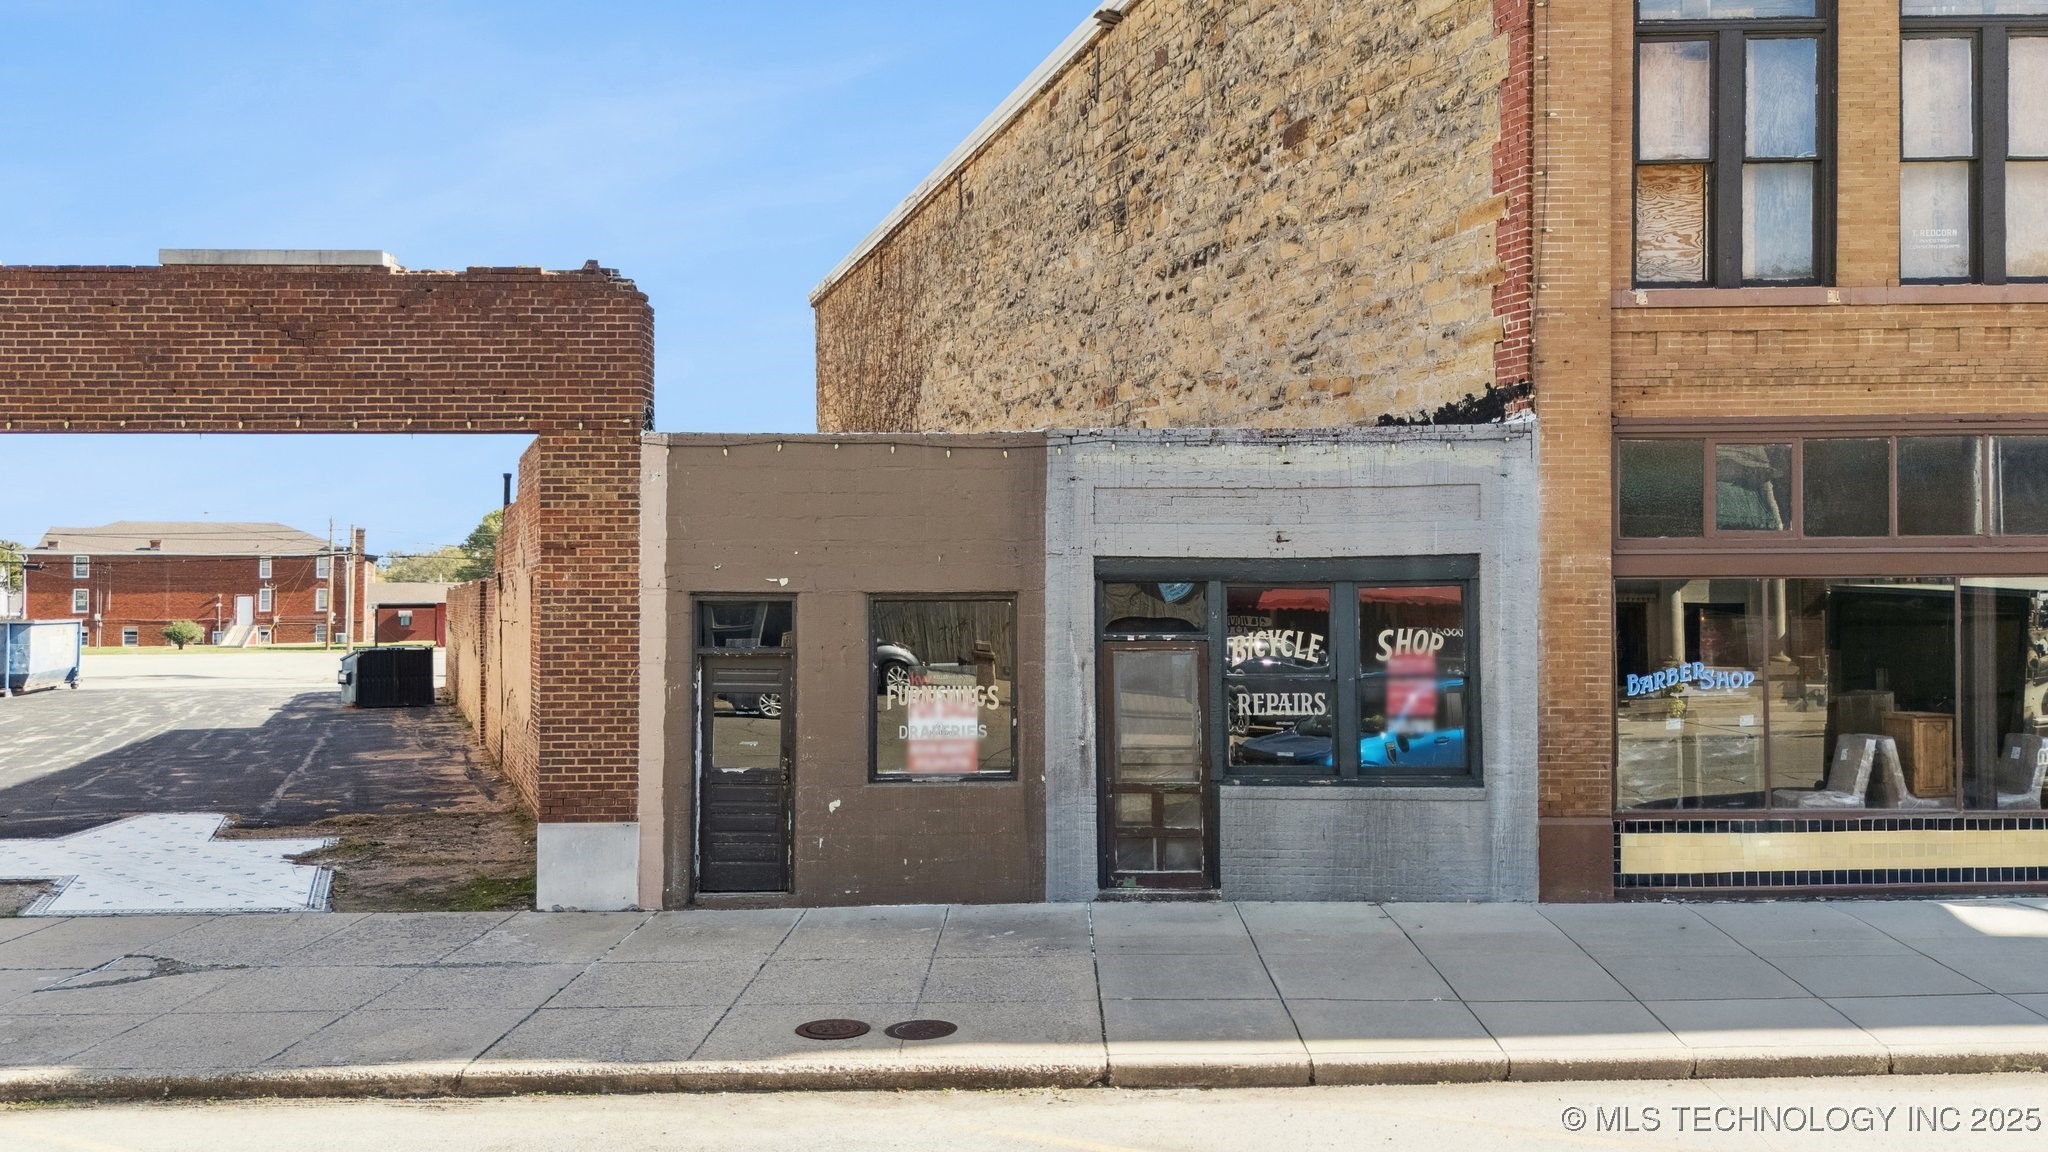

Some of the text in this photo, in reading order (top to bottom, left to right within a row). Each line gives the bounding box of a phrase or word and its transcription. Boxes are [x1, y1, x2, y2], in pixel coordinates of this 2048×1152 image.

[1920, 229, 1958, 237] REDCORN
[1231, 628, 1445, 667] BICYCLE SHOP
[1626, 661, 1755, 697] BARBER SHOP
[886, 685, 1000, 711] FURNISHINGS
[1236, 692, 1327, 716] REPAIRS
